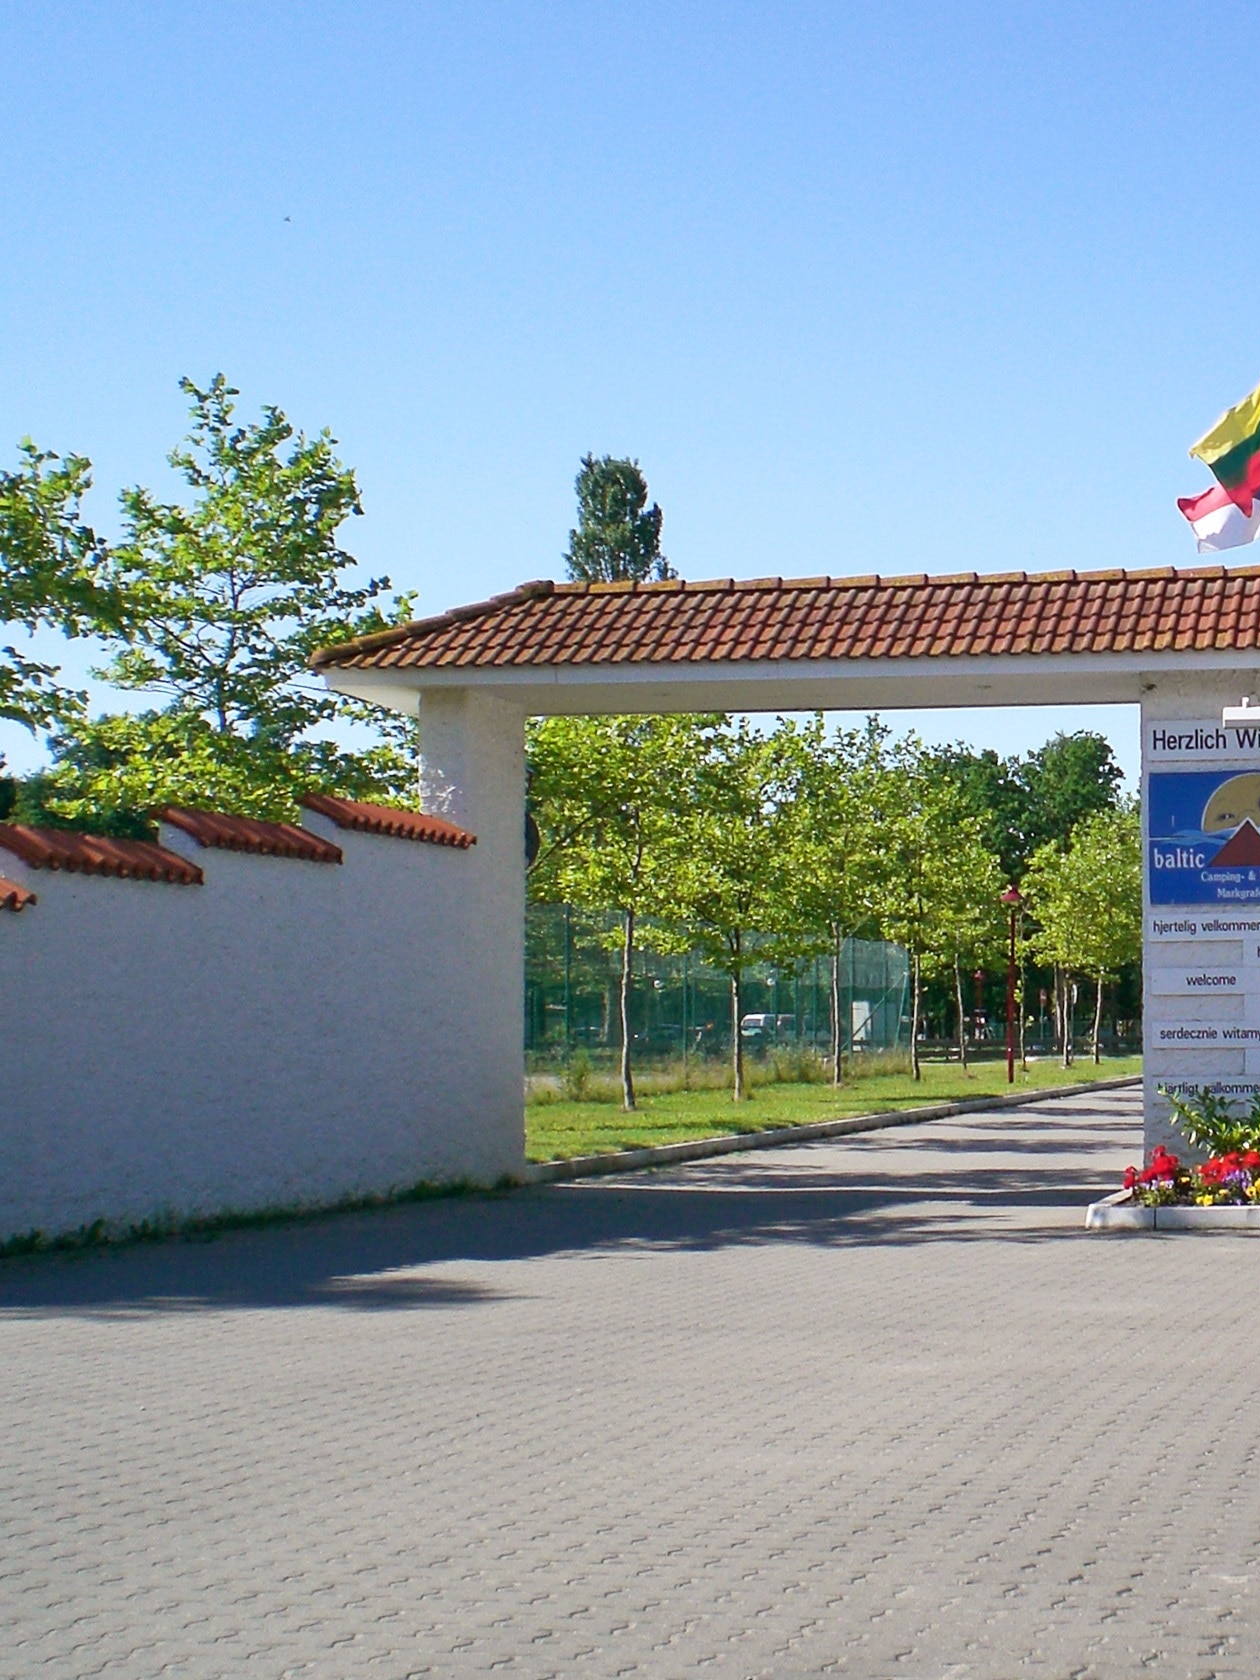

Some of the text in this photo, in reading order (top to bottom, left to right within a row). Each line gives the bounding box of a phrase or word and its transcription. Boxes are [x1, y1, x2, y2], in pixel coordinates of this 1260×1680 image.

[1152, 729, 1227, 750] Herzlich
[1154, 848, 1205, 869] baltic
[1248, 870, 1256, 880] &
[1153, 920, 1197, 935] hjertelig
[1186, 974, 1236, 986] welcome
[1160, 1027, 1217, 1040] serdecznie
